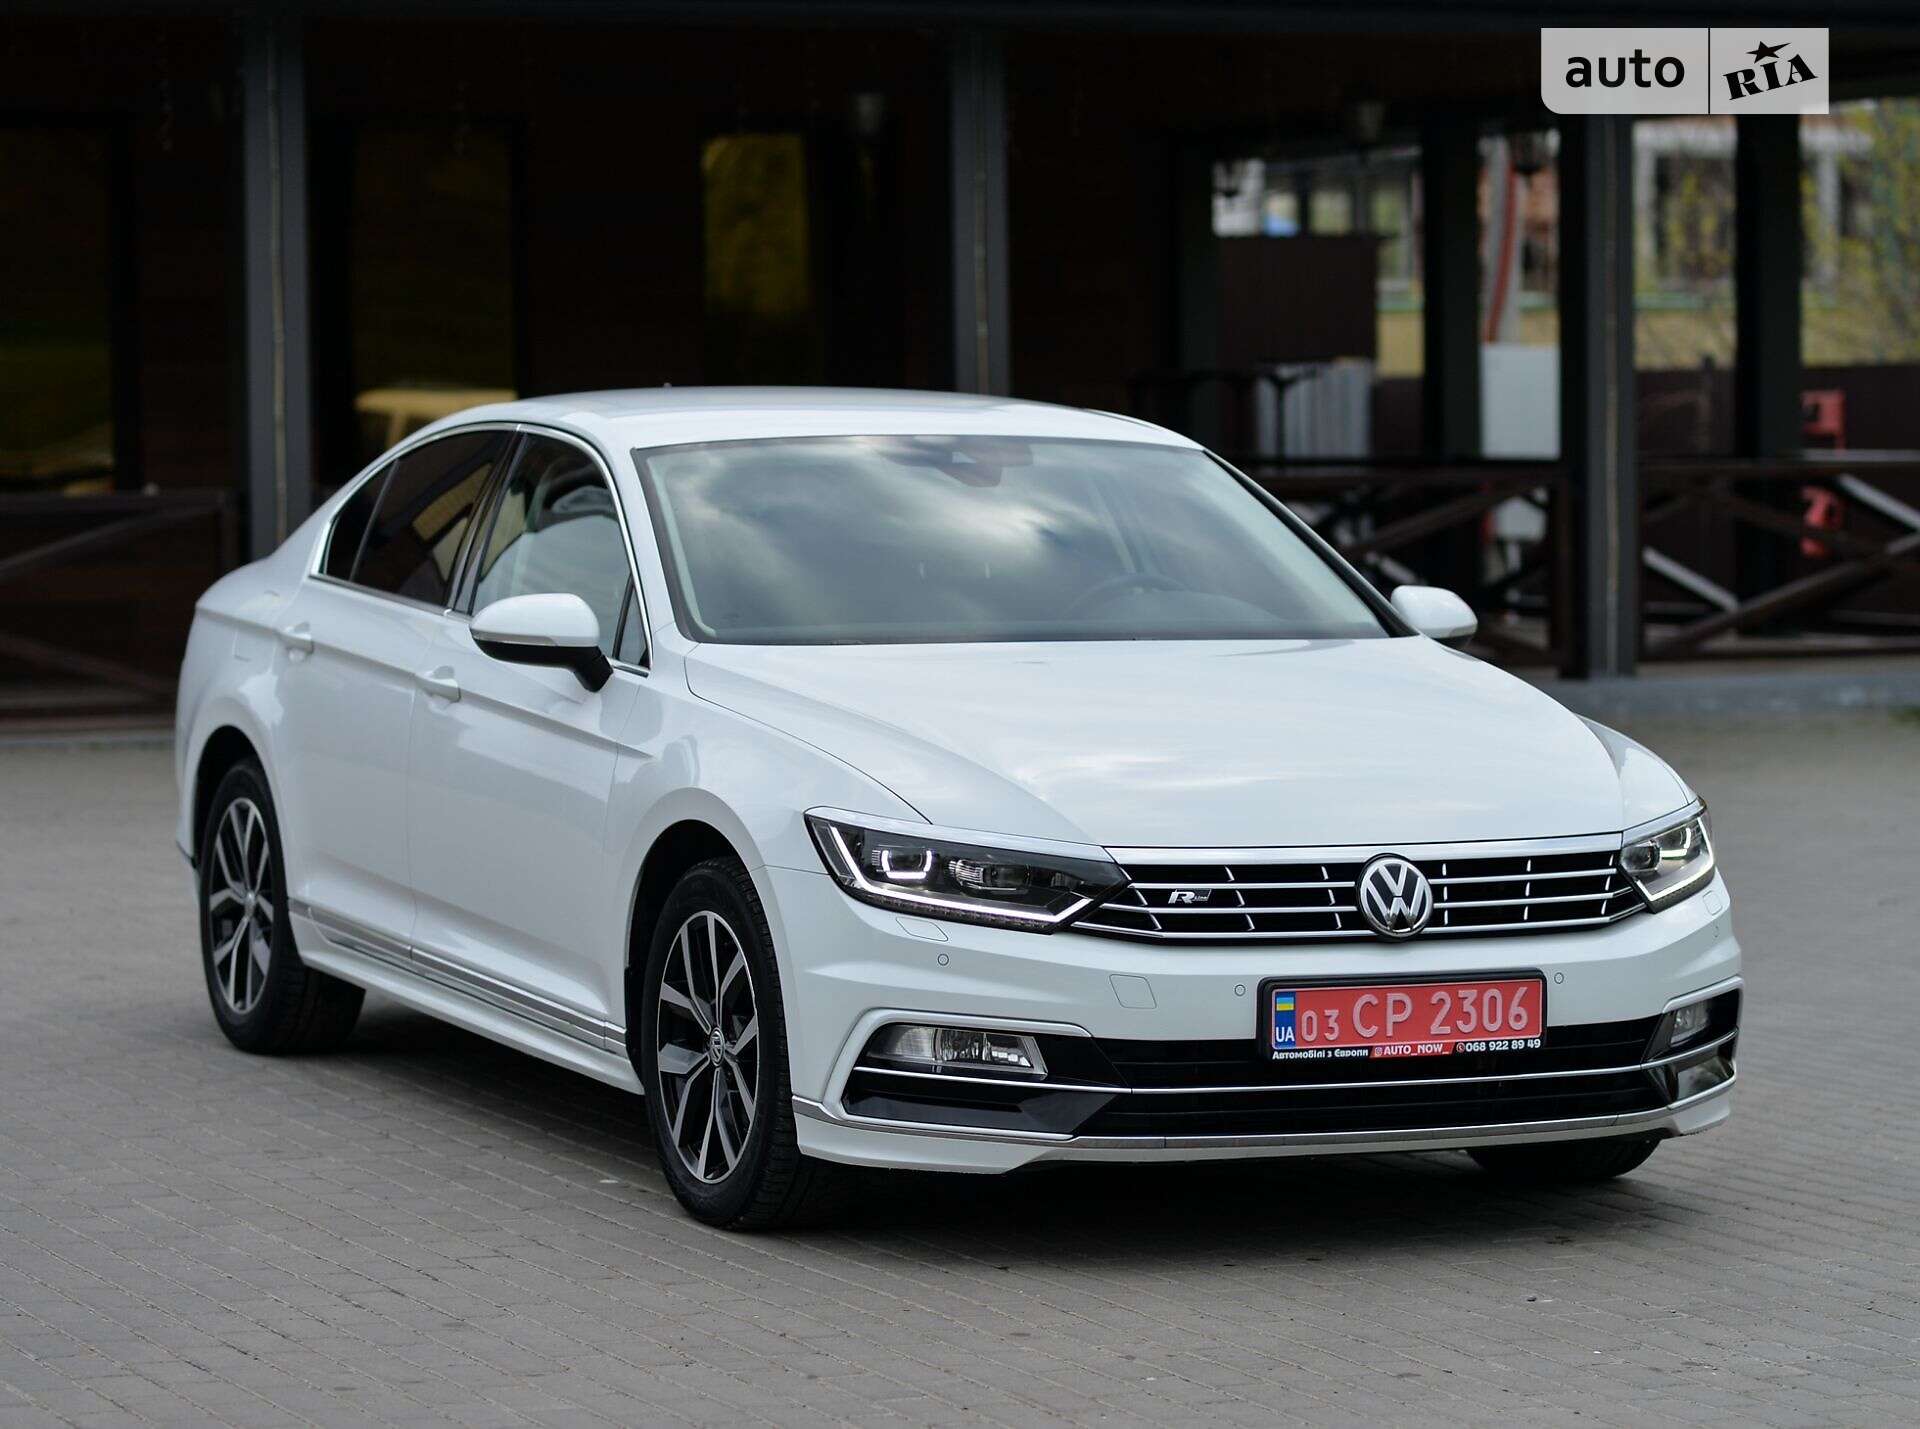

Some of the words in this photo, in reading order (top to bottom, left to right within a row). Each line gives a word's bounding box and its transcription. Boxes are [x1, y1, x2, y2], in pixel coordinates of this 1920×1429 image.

[1301, 1009, 1340, 1042] 03
[1430, 986, 1528, 1036] 2306
[1275, 1026, 1295, 1043] UA
[1465, 1042, 1486, 1052] 068
[1489, 1040, 1509, 1051] 922
[1511, 1040, 1525, 1050] 89
[1527, 1038, 1541, 1049] 49
[1272, 1049, 1326, 1060] Автомобілі
[1334, 1048, 1369, 1058] Європи
